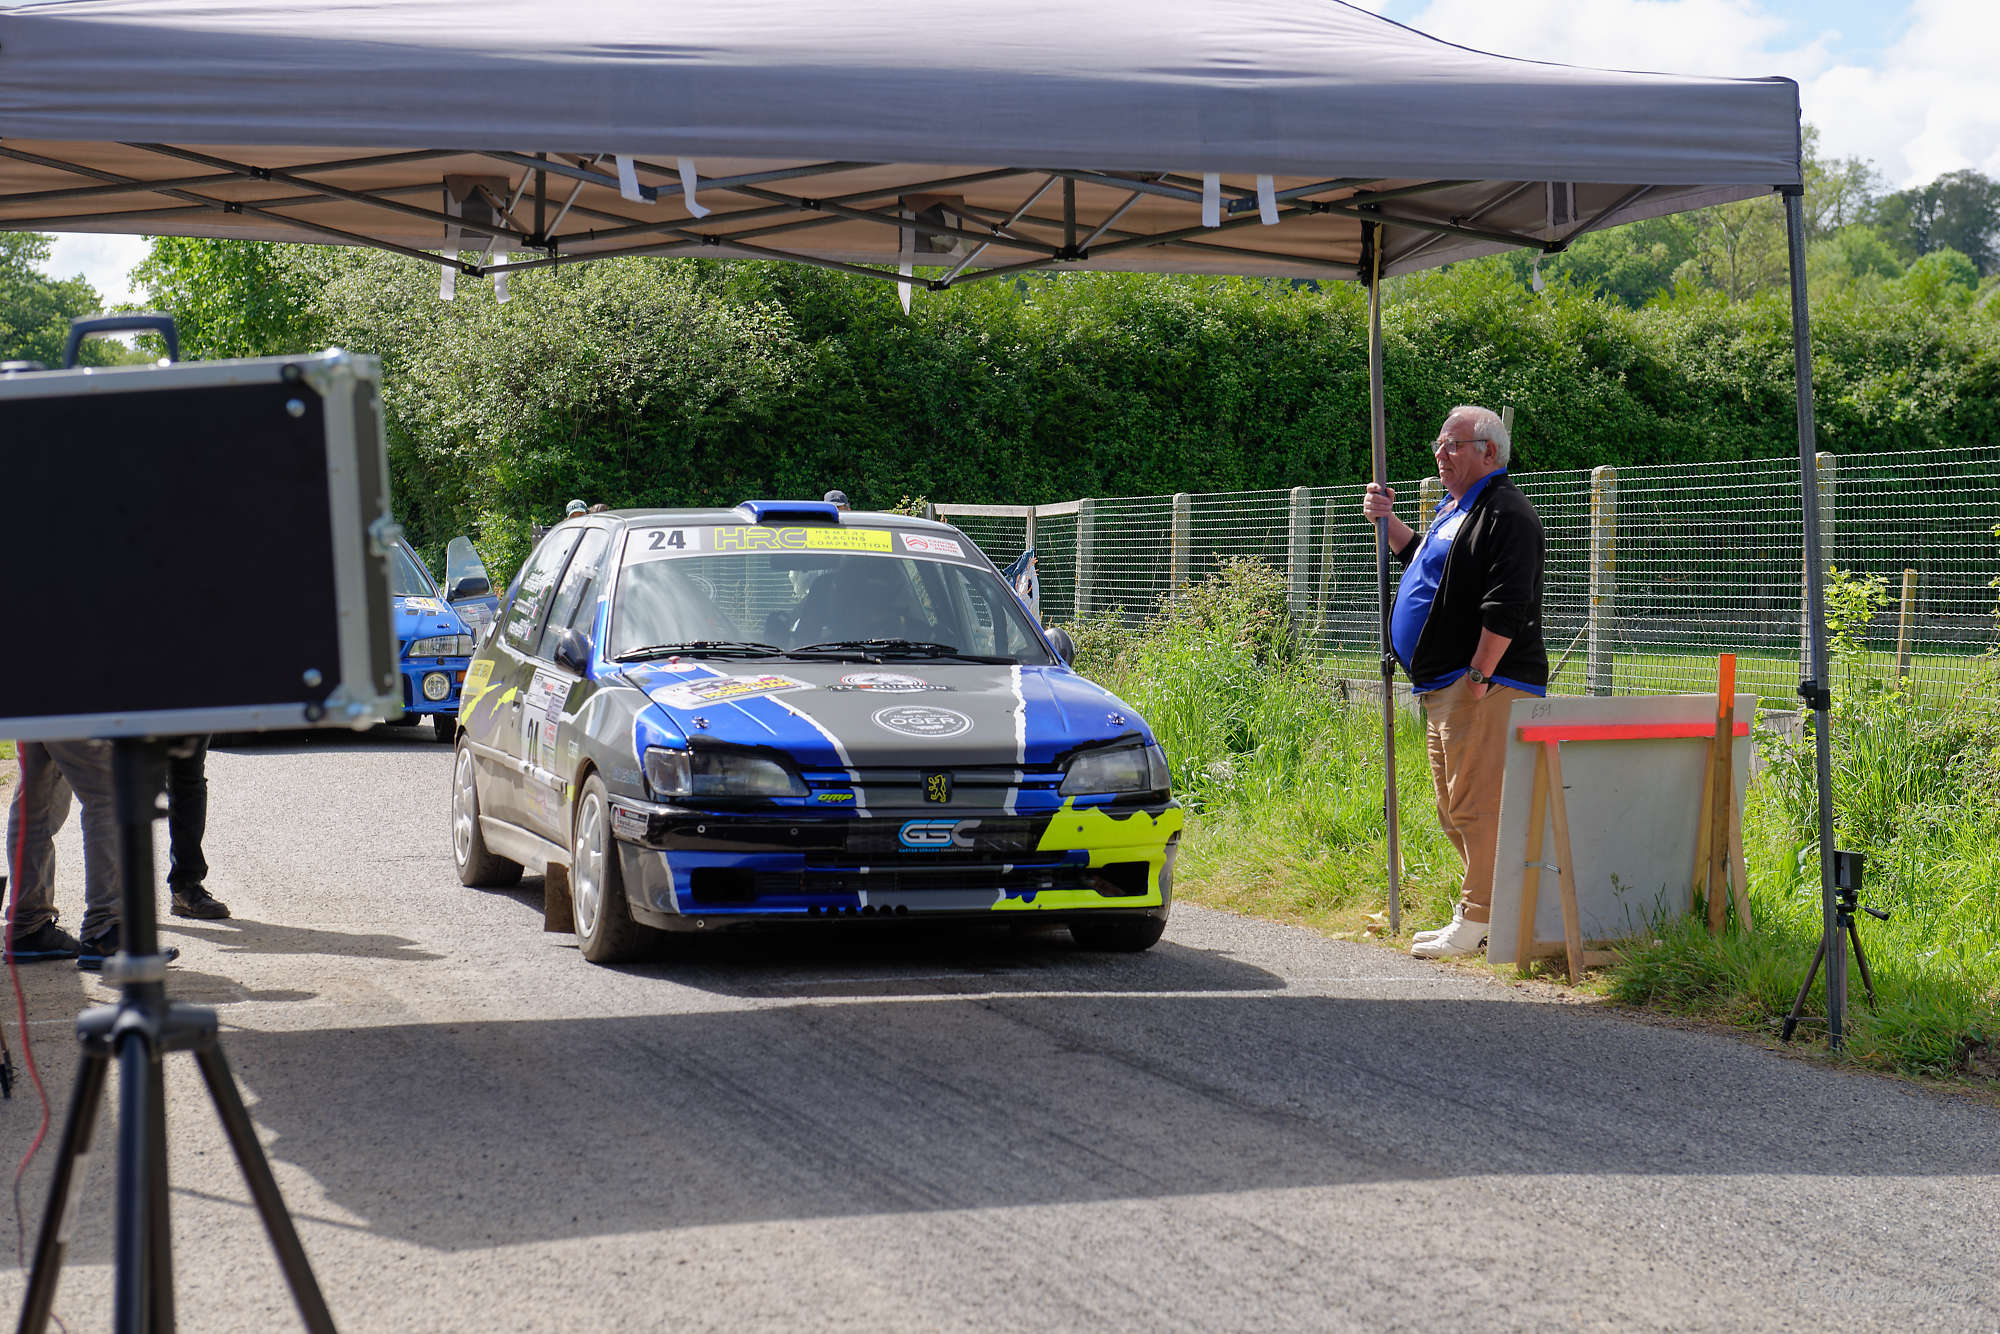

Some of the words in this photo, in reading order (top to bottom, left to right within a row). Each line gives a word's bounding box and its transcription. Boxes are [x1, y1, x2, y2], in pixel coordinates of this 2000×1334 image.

[648, 530, 687, 550] 24
[714, 527, 808, 550] HRC
[809, 540, 889, 549] COMPETITION
[890, 717, 957, 725] OGER
[898, 819, 982, 847] GSC
